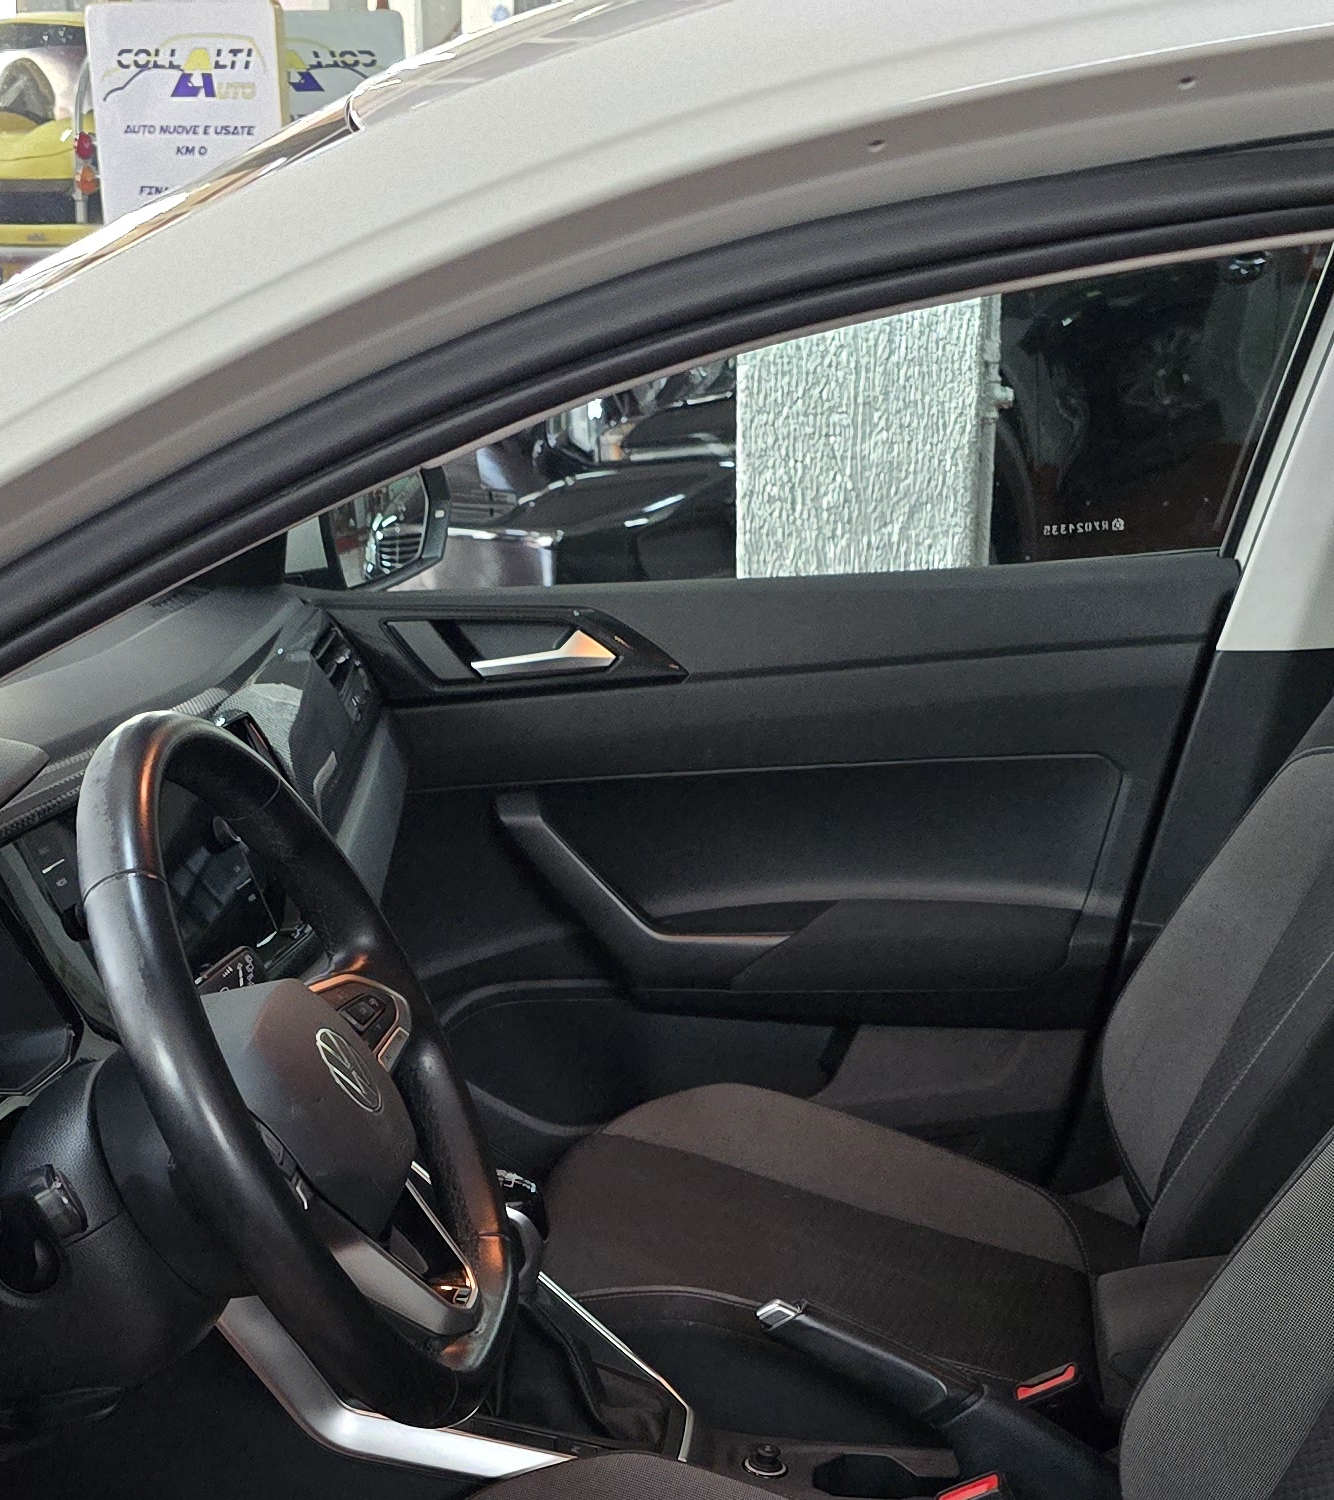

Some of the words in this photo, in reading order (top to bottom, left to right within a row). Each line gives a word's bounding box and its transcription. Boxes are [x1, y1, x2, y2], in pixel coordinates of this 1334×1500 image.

[117, 47, 253, 71] COLLALTI
[124, 125, 156, 136] AUTO
[159, 125, 200, 136] NUOVE
[203, 126, 212, 136] E
[214, 125, 255, 136] USATE
[176, 145, 195, 156] KM
